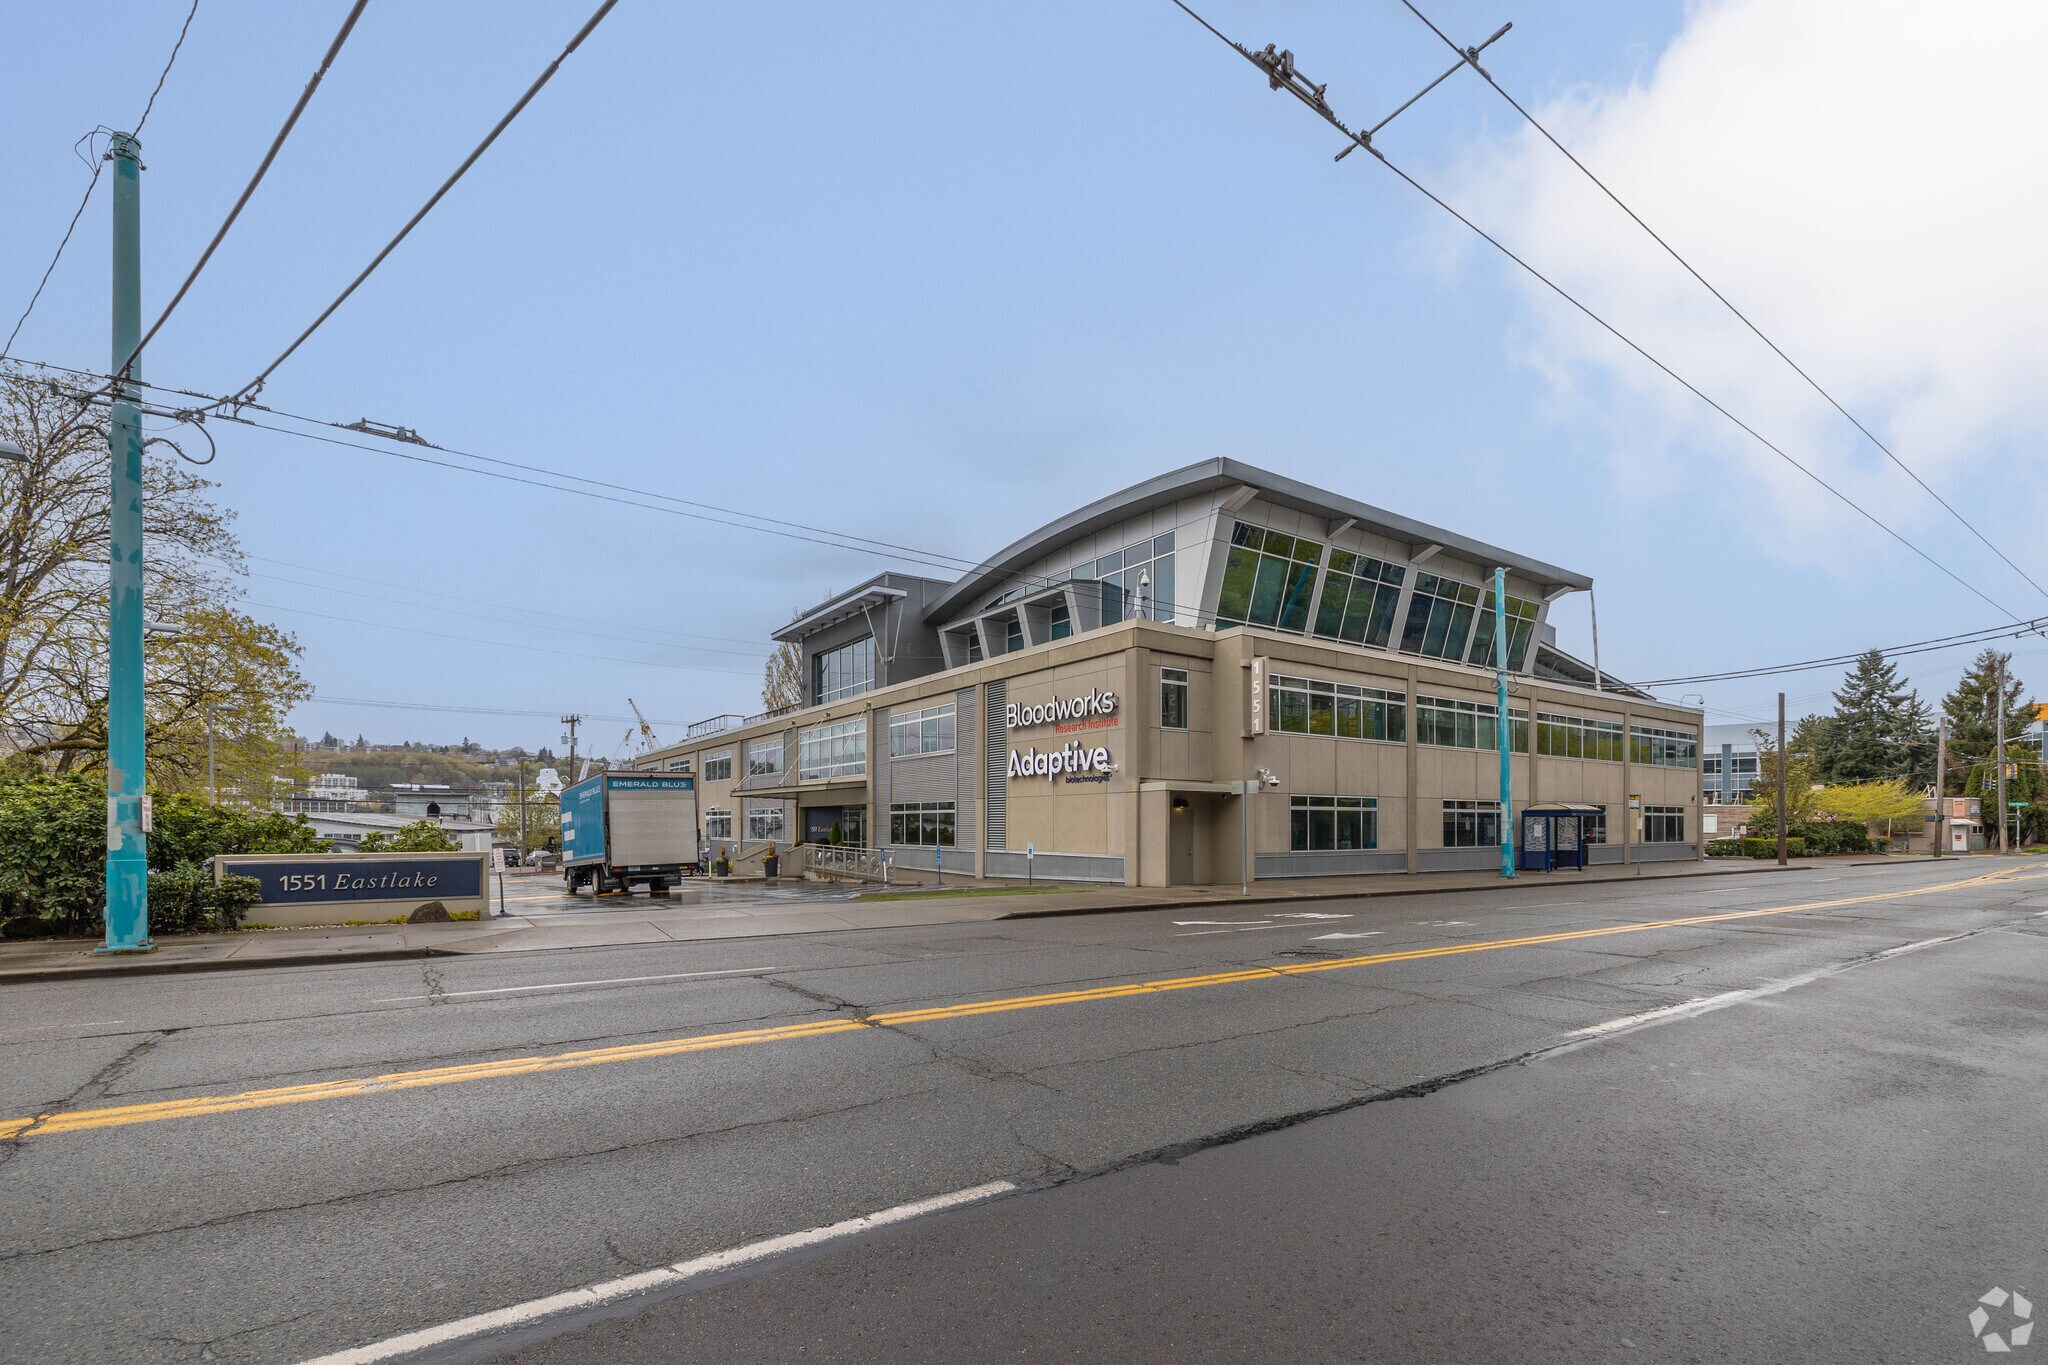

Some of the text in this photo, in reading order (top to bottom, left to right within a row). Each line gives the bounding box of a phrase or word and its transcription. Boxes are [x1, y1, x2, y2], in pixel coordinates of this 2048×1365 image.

[1006, 688, 1115, 728] Bloodworks
[1253, 661, 1261, 732] 1551
[1055, 717, 1119, 734] Research Institute
[1007, 740, 1109, 782] Adaptive
[612, 780, 659, 788] EMERALD
[279, 871, 438, 892] 1551 Eastlake
